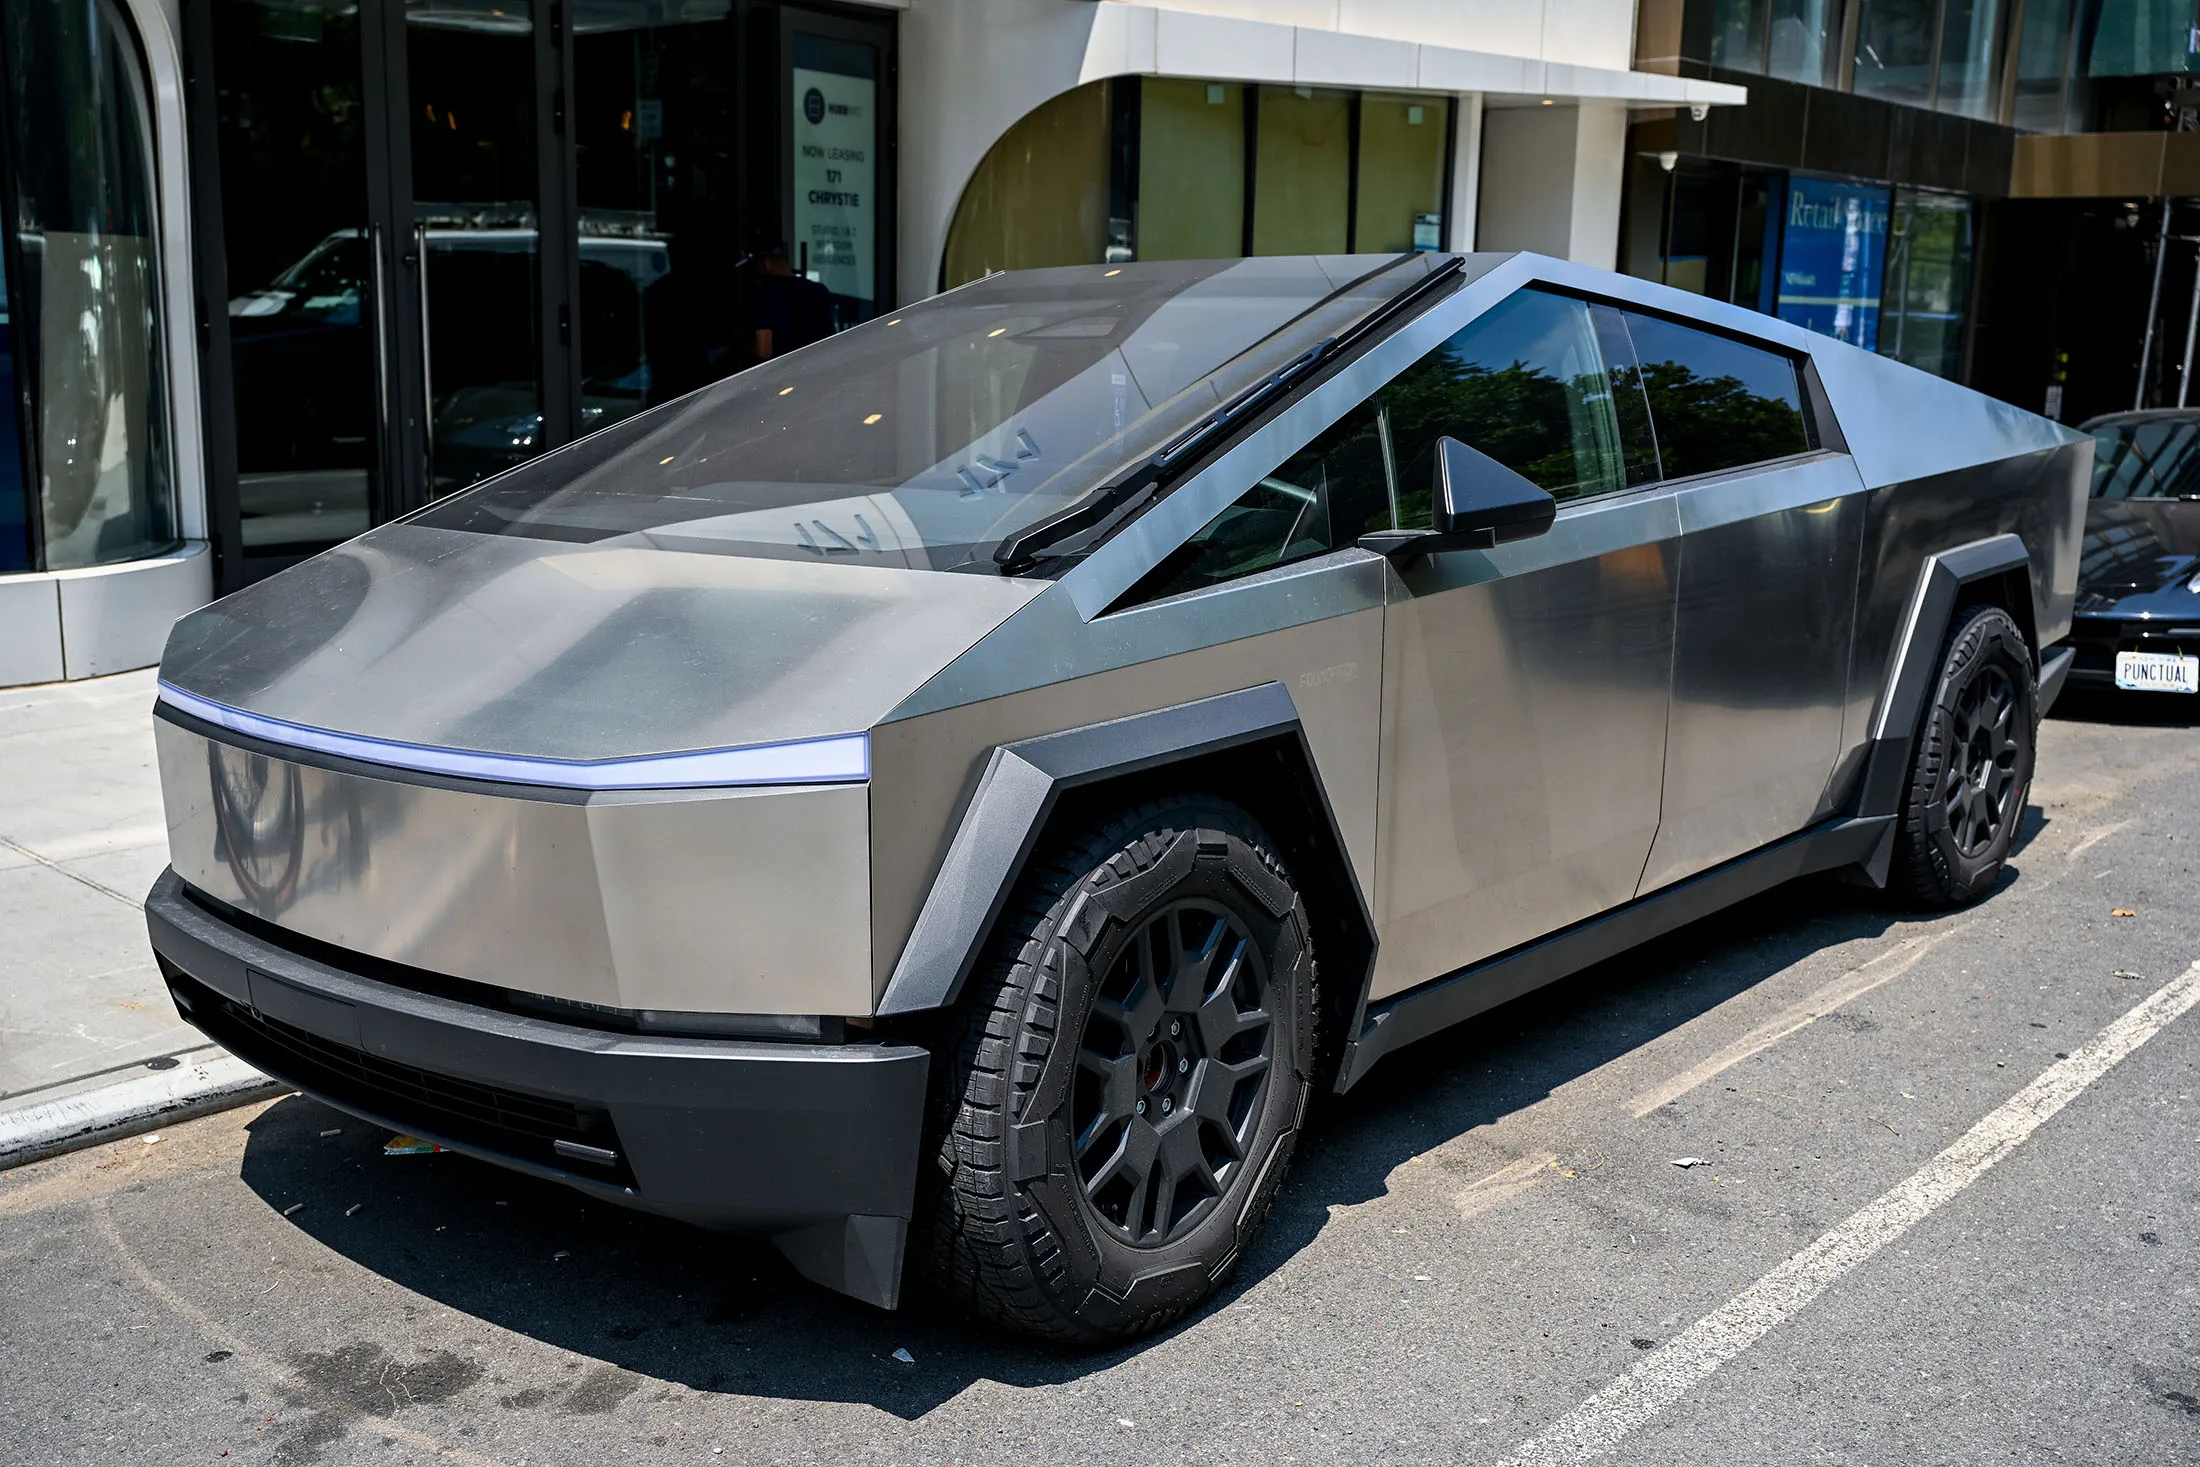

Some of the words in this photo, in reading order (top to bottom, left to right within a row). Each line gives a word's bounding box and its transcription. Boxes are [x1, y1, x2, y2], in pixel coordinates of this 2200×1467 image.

[802, 145, 824, 158] NOW
[827, 147, 865, 163] LEASING
[826, 169, 842, 184] 171
[808, 190, 860, 207] CHRYSTIE
[1790, 191, 1840, 229] Retail
[2124, 663, 2188, 683] PUNCTUAL
